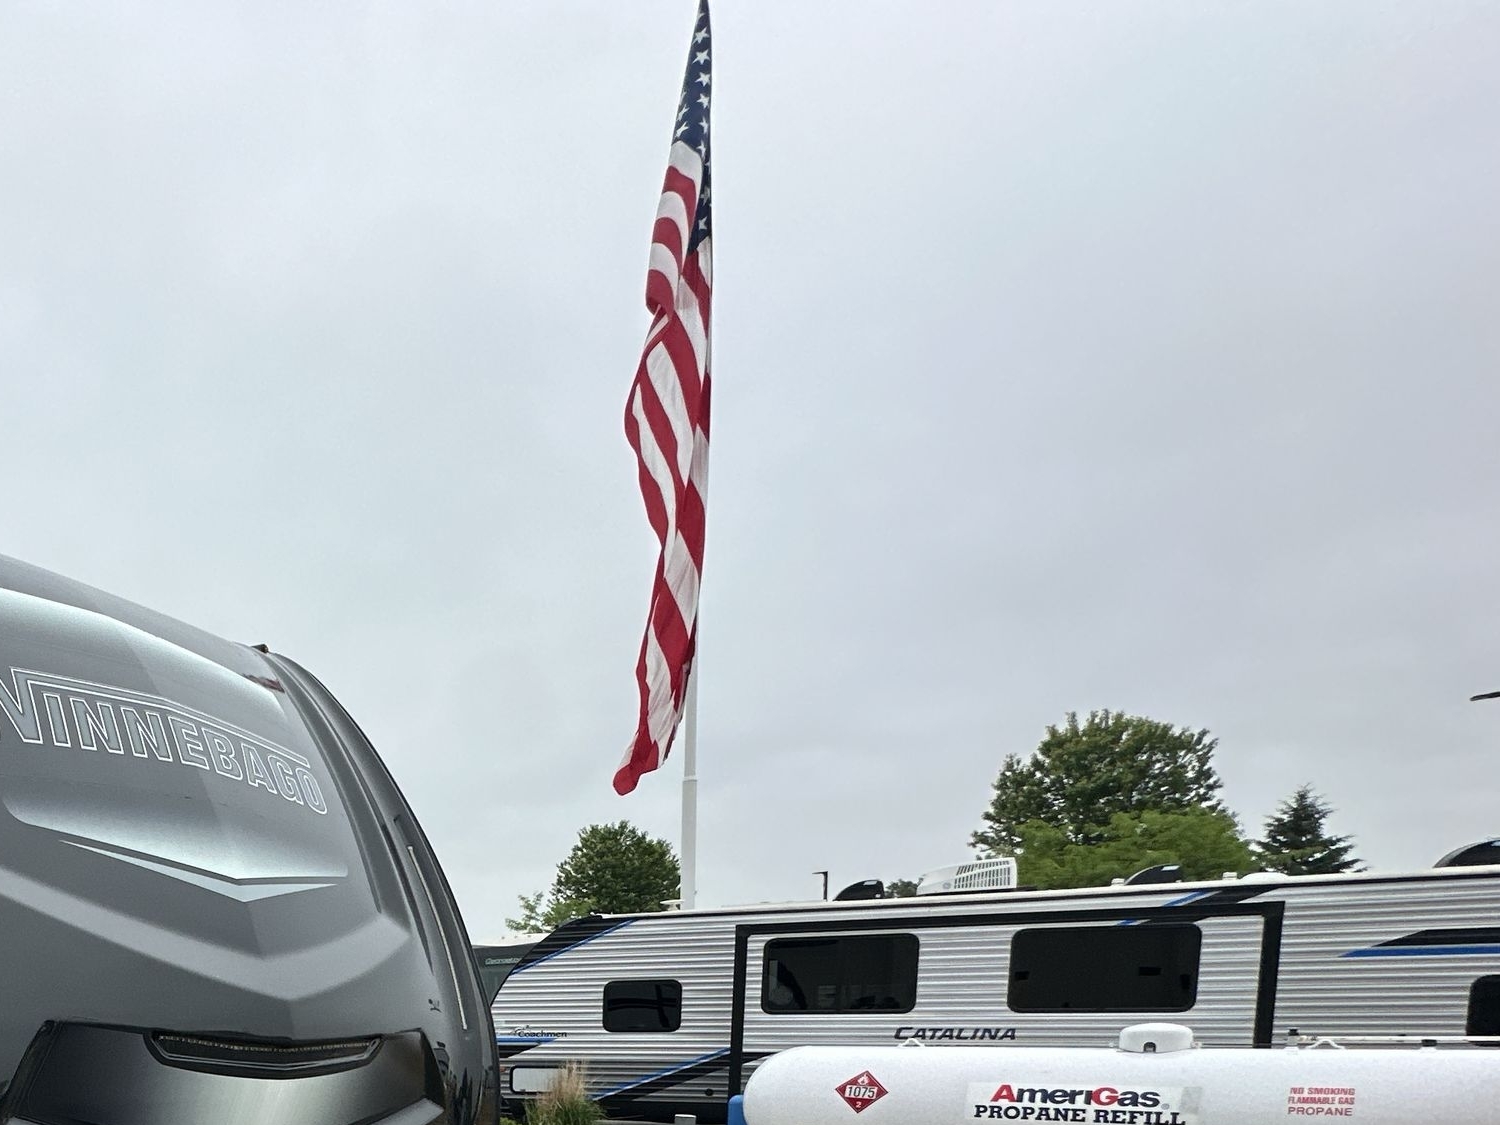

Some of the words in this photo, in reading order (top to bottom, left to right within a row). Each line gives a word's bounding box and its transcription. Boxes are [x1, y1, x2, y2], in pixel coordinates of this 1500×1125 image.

[894, 1026, 1017, 1040] CATALINA
[848, 1086, 875, 1098] 1075
[990, 1084, 1161, 1108] AmeriGas
[1307, 1087, 1355, 1095] SMOKING
[1288, 1096, 1336, 1104] FLAMMABLE
[1338, 1096, 1355, 1105] GAS
[974, 1104, 1086, 1122] PROPANE
[1287, 1106, 1353, 1116] PROPANE
